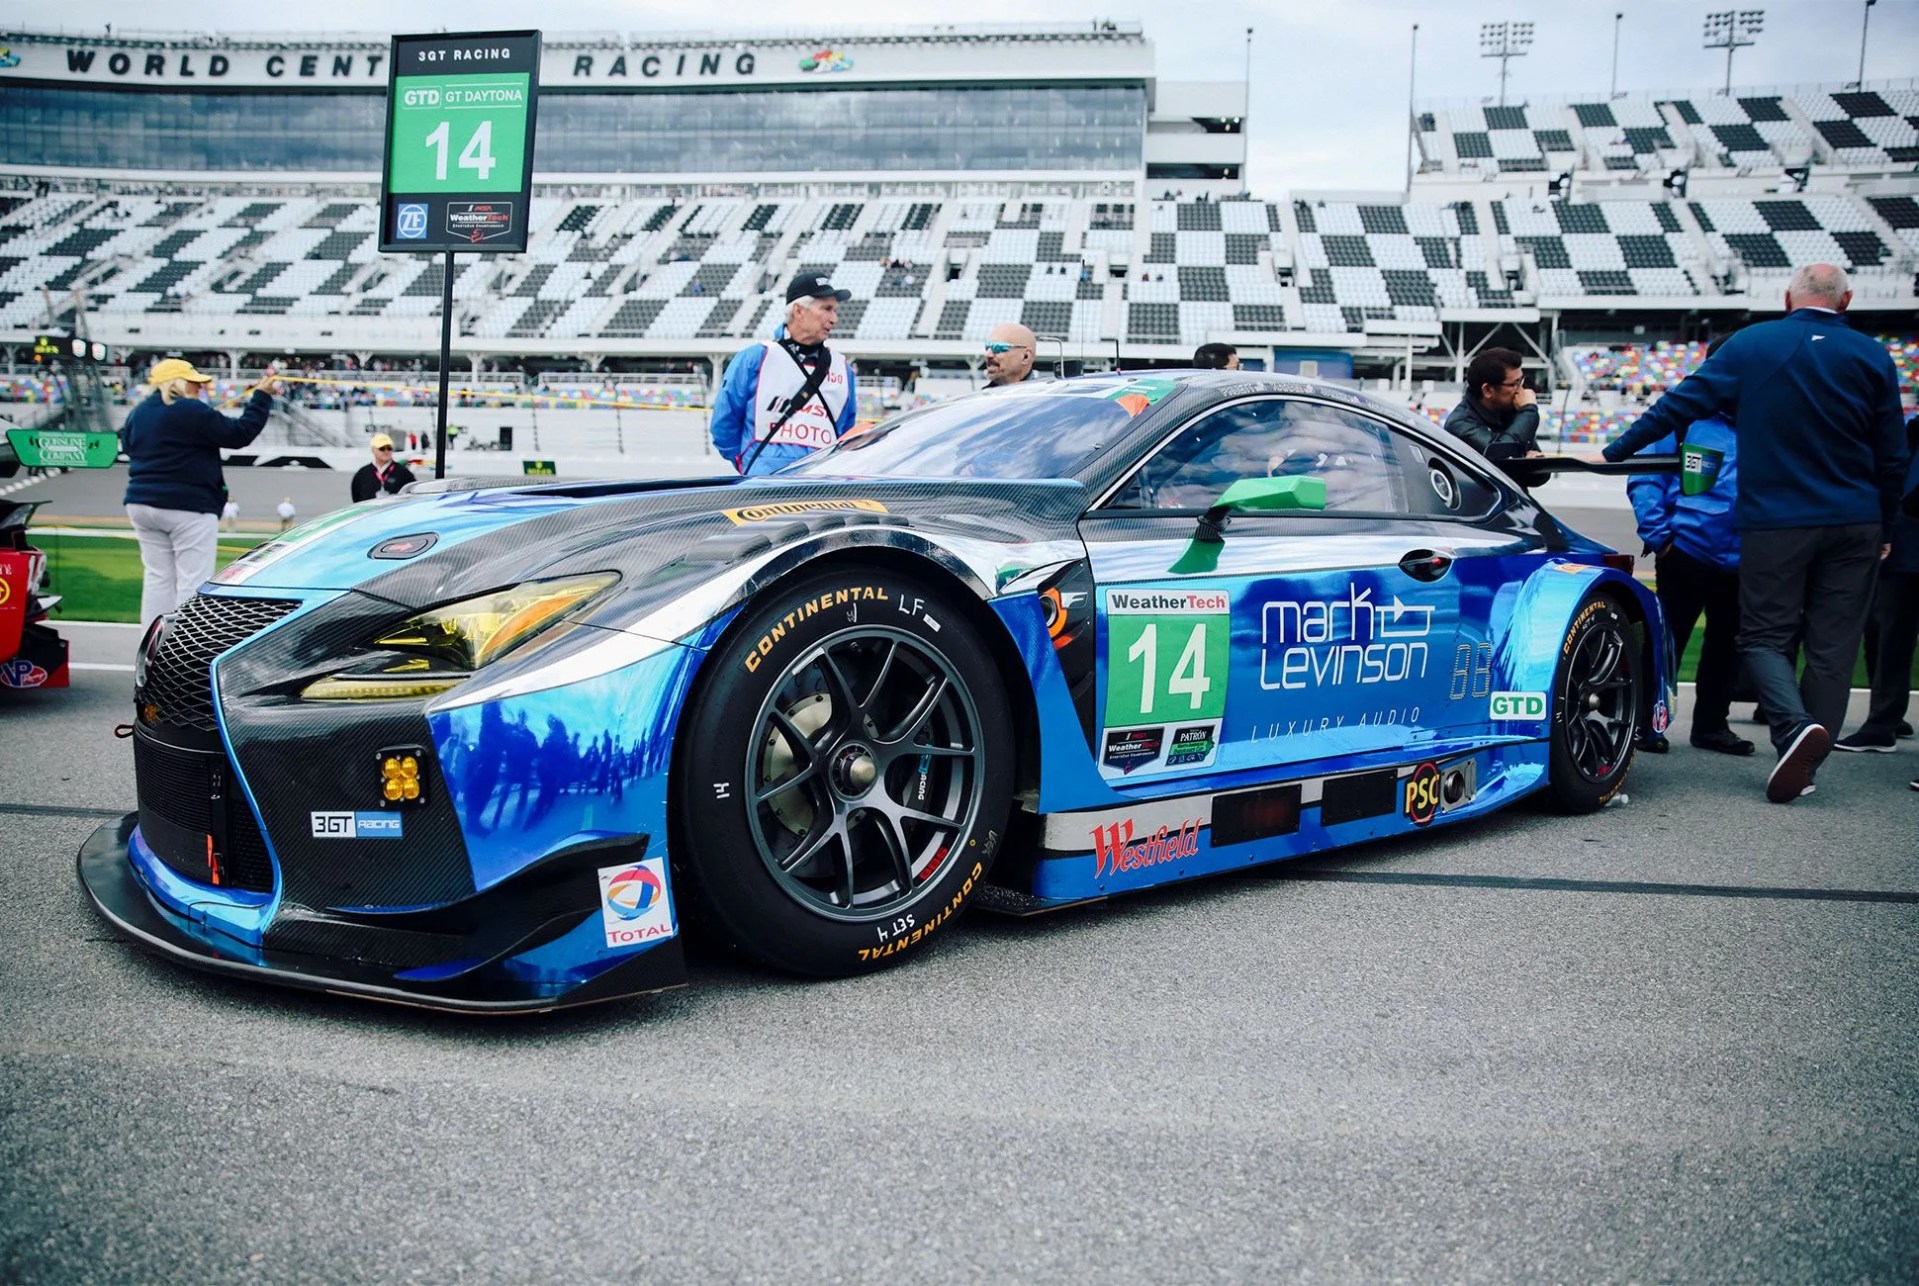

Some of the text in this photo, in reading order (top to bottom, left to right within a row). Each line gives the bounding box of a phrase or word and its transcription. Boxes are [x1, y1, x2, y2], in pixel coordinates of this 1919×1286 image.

[67, 50, 756, 77] WORLD CENT RACING
[418, 48, 511, 61] 3GT RACING
[404, 89, 522, 105] GTD GT DAYTONA
[425, 120, 496, 181] 14
[401, 211, 425, 231] ZF
[450, 213, 509, 222] WeatherTech
[737, 499, 857, 522] Continental
[898, 594, 925, 616] LF
[1112, 594, 1226, 609] WeatherTech
[1262, 582, 1375, 644] mark
[744, 586, 889, 673] CONTINENTAL
[1563, 601, 1606, 655] CONTINENTAL
[1127, 623, 1210, 715] 14
[1492, 696, 1544, 716] GTD
[1251, 706, 1420, 743] LUXURY AUDIO
[1405, 774, 1440, 814] PSC
[314, 816, 352, 833] 3GT
[1089, 817, 1203, 879] Westfield
[858, 861, 983, 962] CONTINENTAL
[892, 913, 916, 937] SET
